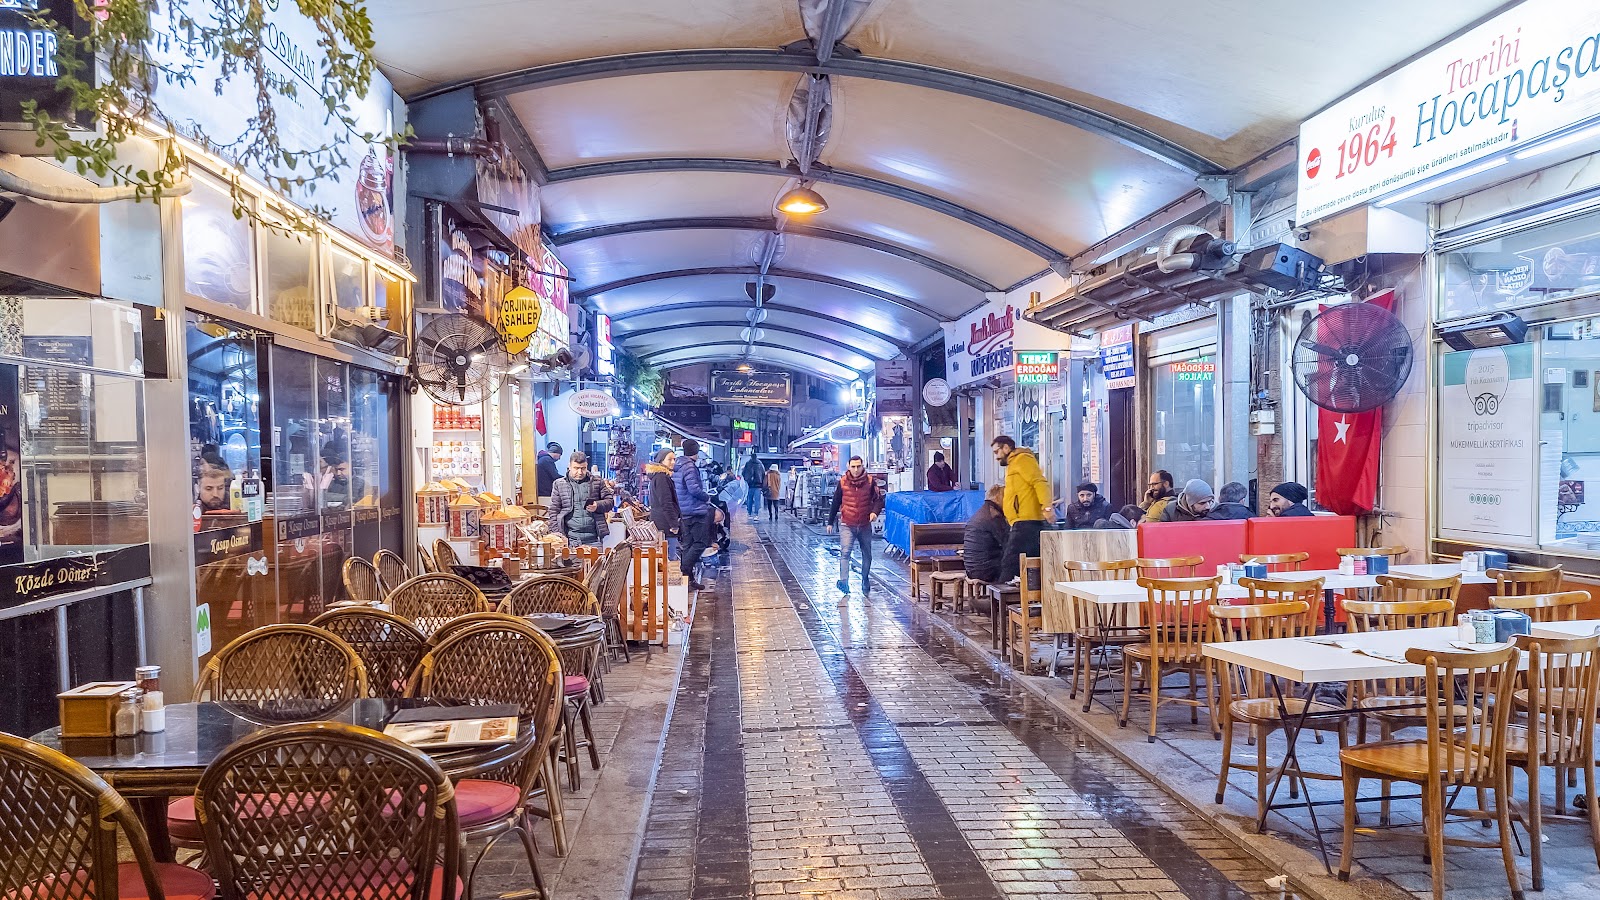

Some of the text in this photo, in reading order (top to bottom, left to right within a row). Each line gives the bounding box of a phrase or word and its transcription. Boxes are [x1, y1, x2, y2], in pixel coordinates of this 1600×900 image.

[268, 22, 315, 85] OSMAN
[1446, 27, 1523, 95] Tarihi
[1412, 33, 1600, 148] Hocapaşa
[1348, 105, 1386, 132] Kuruluş
[1335, 116, 1397, 179] 1964
[1368, 180, 1381, 194] geri
[1431, 152, 1459, 169] ürünleri
[1460, 131, 1509, 157] satılmaktadır
[504, 299, 538, 312] ORJINAL
[505, 312, 538, 326] SAHLEP
[215, 327, 247, 340] Sice
[1021, 353, 1051, 364] TERZİ
[1016, 364, 1058, 374] ERDOĞAN
[1478, 364, 1495, 373] 2015
[1018, 374, 1048, 382] TAILOR
[1467, 420, 1504, 433] tripadvisor
[1450, 438, 1524, 449] MÜKEMMELLİK SERTİFİKASI
[210, 533, 249, 554] Kasap Osman
[15, 565, 93, 595] Közde Döner
